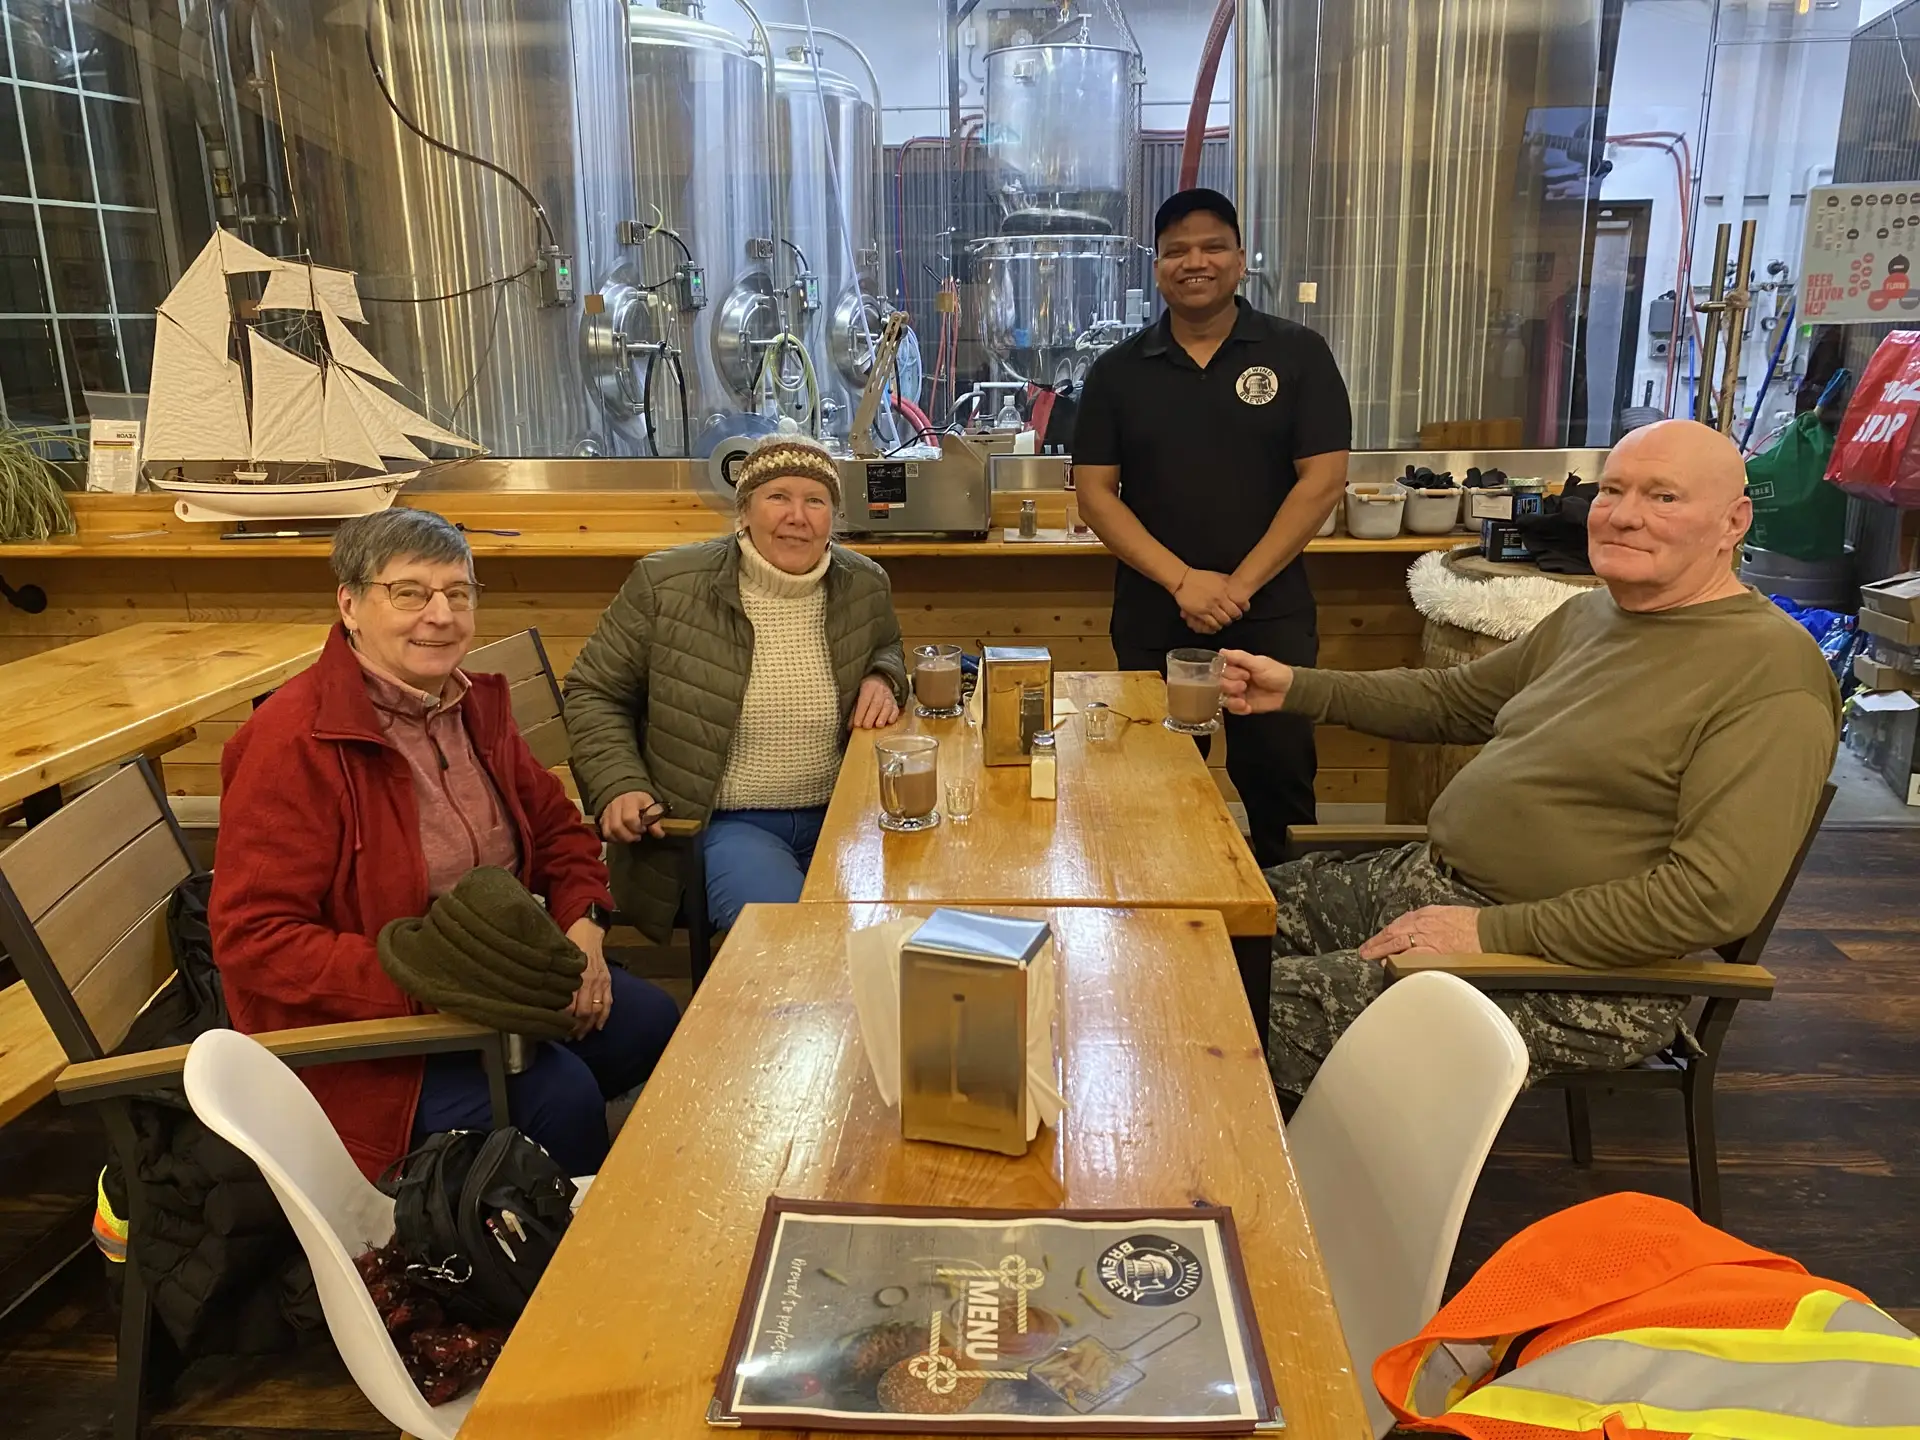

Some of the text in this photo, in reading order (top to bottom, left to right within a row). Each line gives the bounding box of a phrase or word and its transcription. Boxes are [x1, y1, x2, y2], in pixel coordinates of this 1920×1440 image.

[1807, 274, 1833, 287] BEER
[1806, 287, 1844, 300] FLAVOR
[1252, 368, 1273, 377] WIND
[1239, 387, 1276, 404] BREWERY
[783, 1258, 808, 1298] Brewed
[1101, 1241, 1145, 1302] BREWERY
[1174, 1262, 1200, 1297] WIND
[781, 1299, 798, 1314] to
[965, 1281, 999, 1361] MENU
